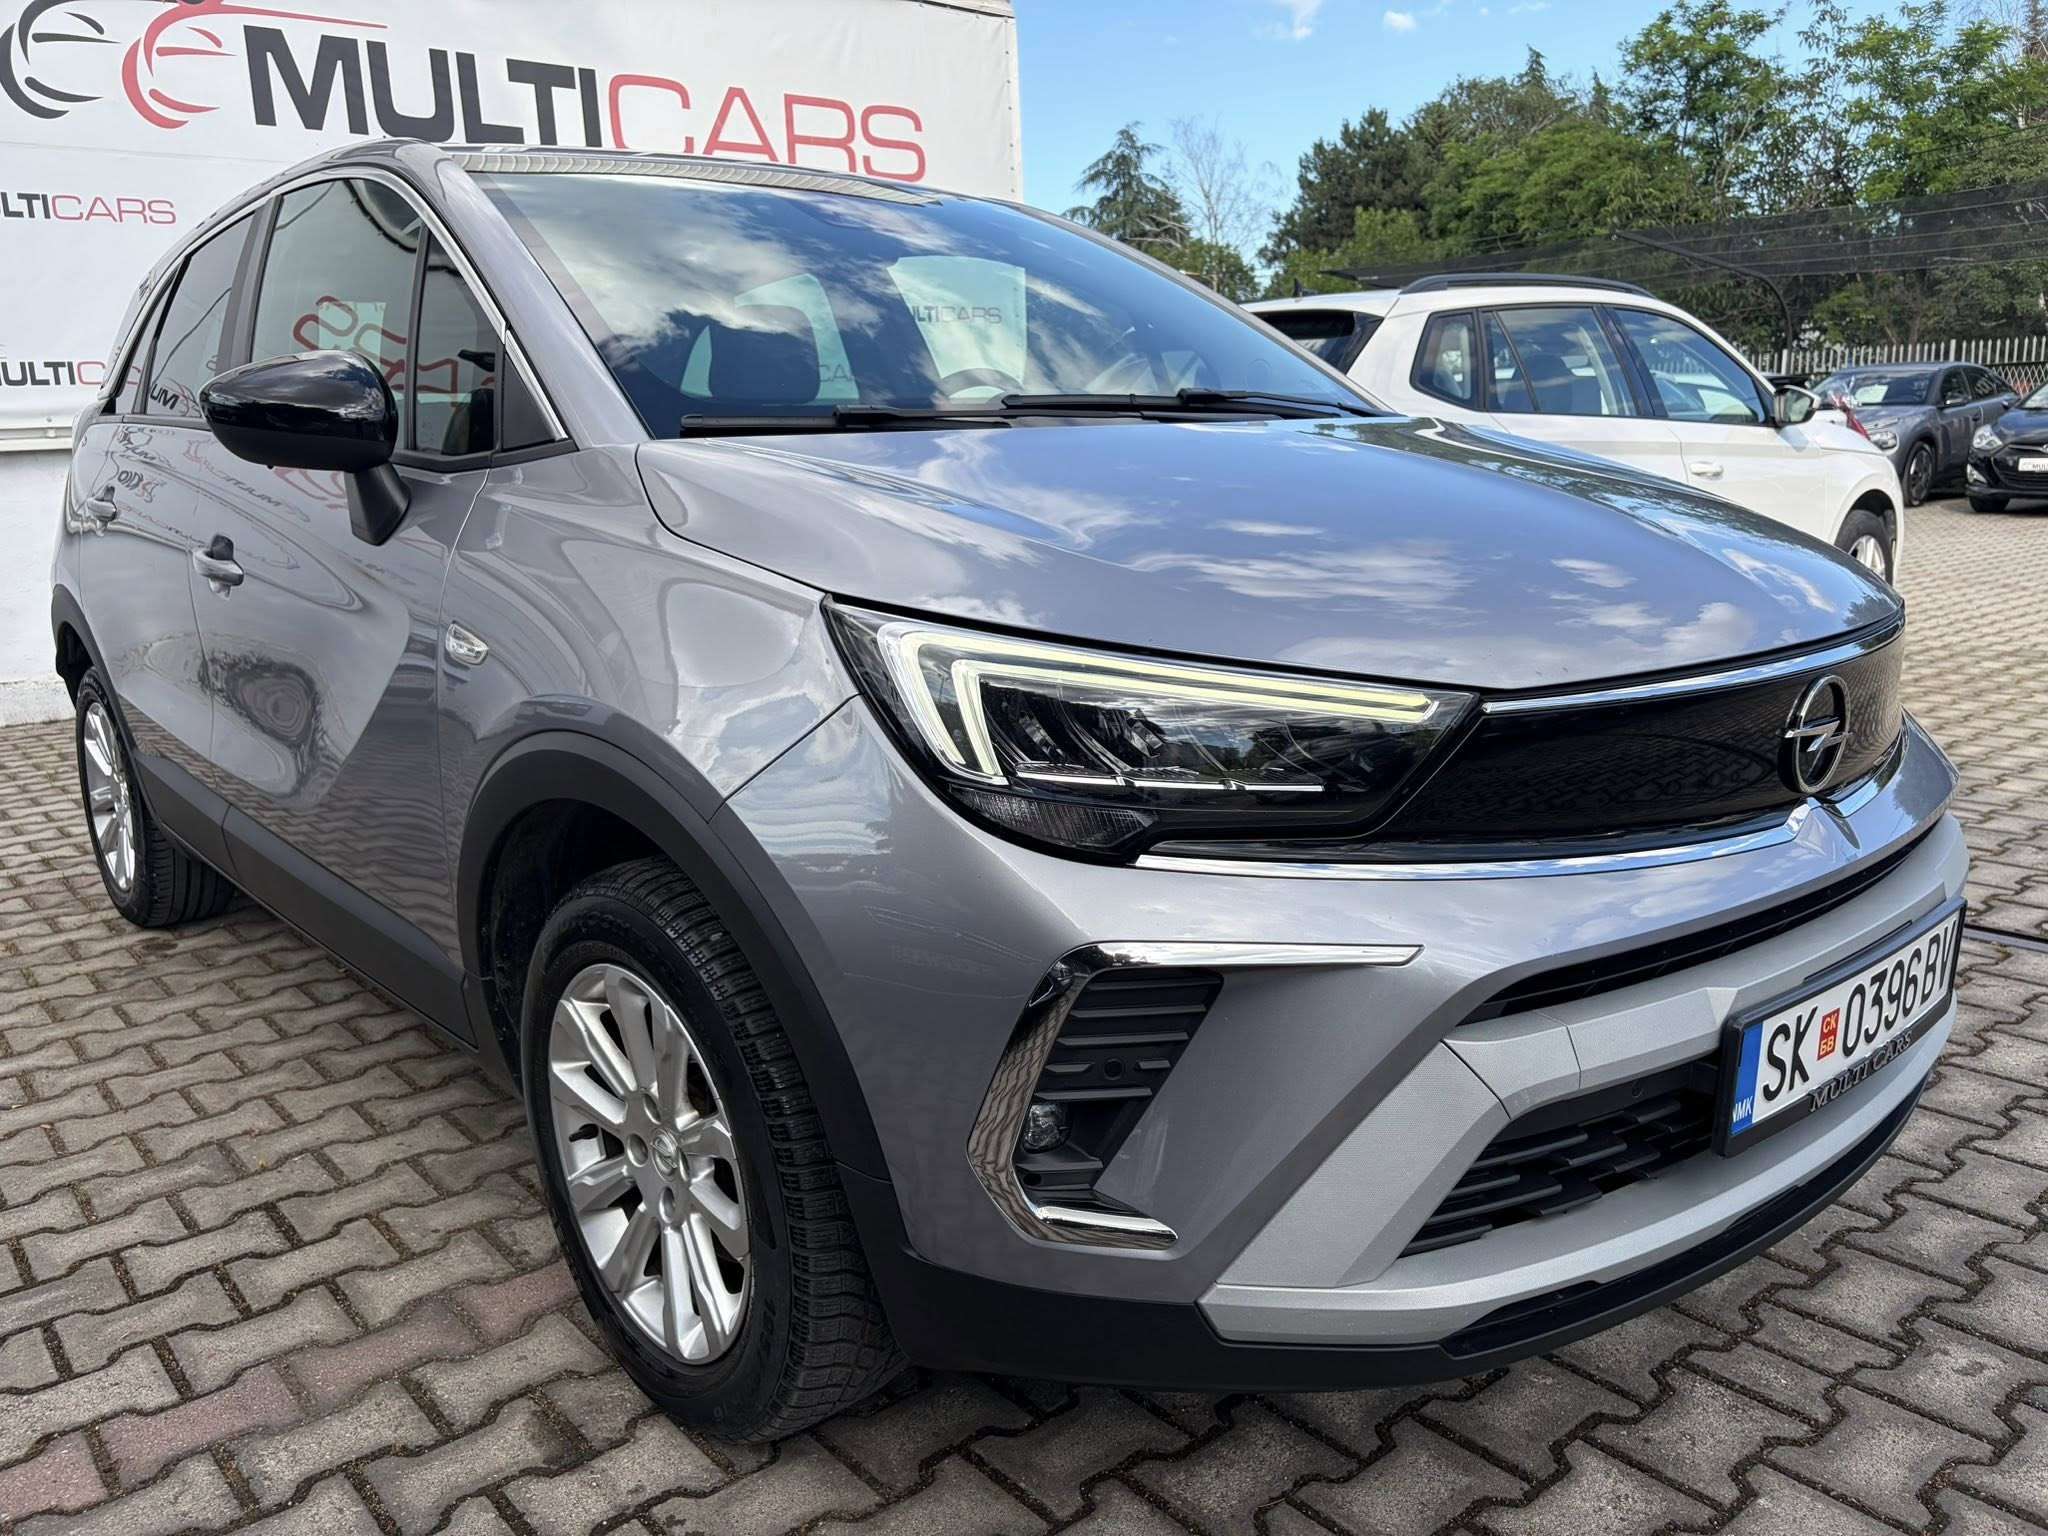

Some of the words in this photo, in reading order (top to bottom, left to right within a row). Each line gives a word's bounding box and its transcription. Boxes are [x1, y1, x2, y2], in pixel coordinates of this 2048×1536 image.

[244, 24, 927, 182] MULTICARS
[0, 191, 177, 225] LTICARS
[1762, 1006, 1818, 1102] SK
[1810, 1064, 1871, 1113] MULTI
